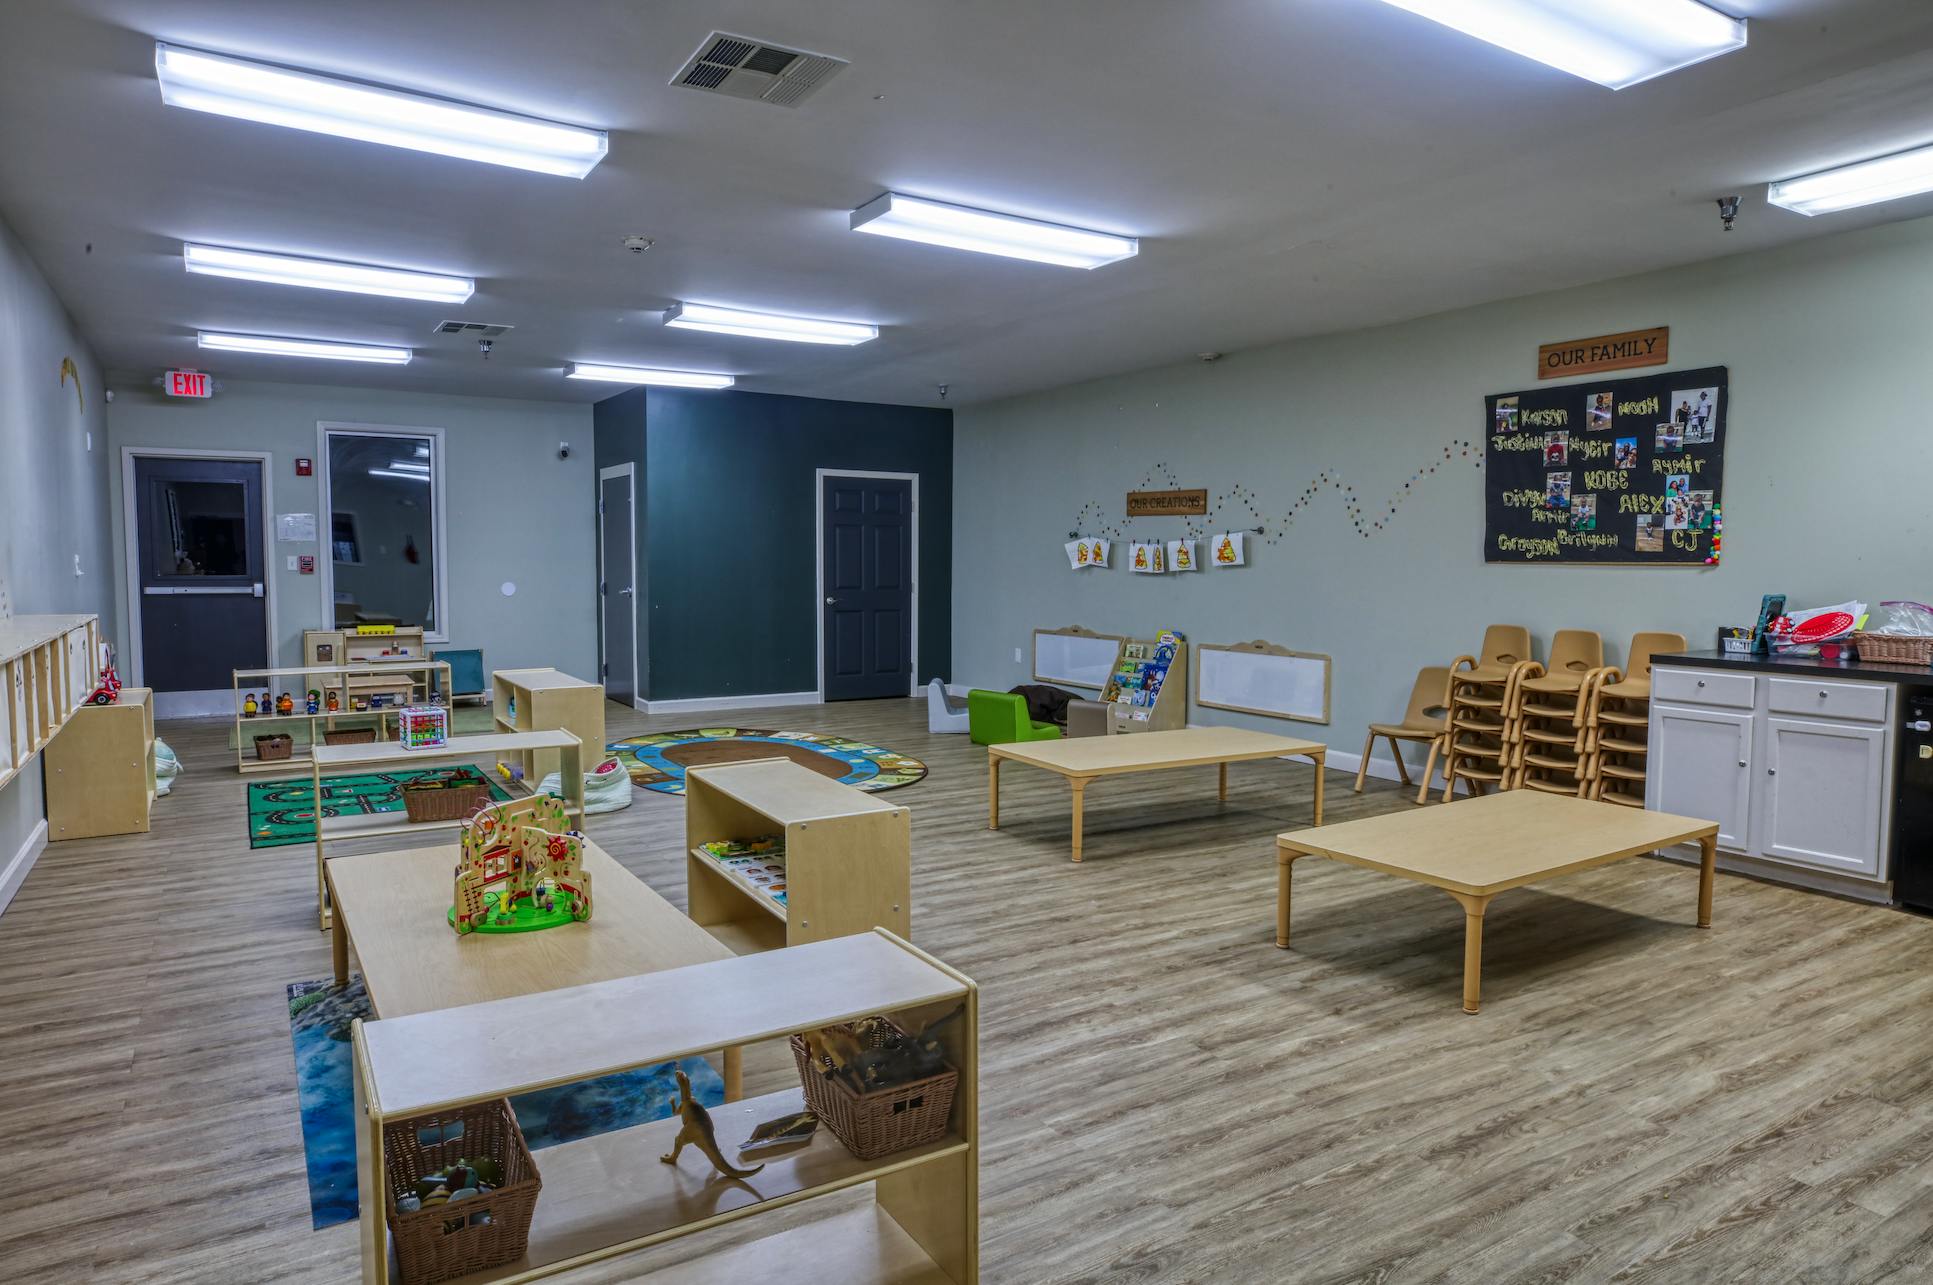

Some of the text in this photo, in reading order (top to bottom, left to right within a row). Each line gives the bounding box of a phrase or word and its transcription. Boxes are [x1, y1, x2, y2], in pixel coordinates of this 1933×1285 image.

[1547, 337, 1658, 368] OUR FAMILY
[172, 372, 206, 396] EXIT
[1129, 495, 1201, 509] OUR CREATIONS
[1671, 529, 1704, 552] CJ
